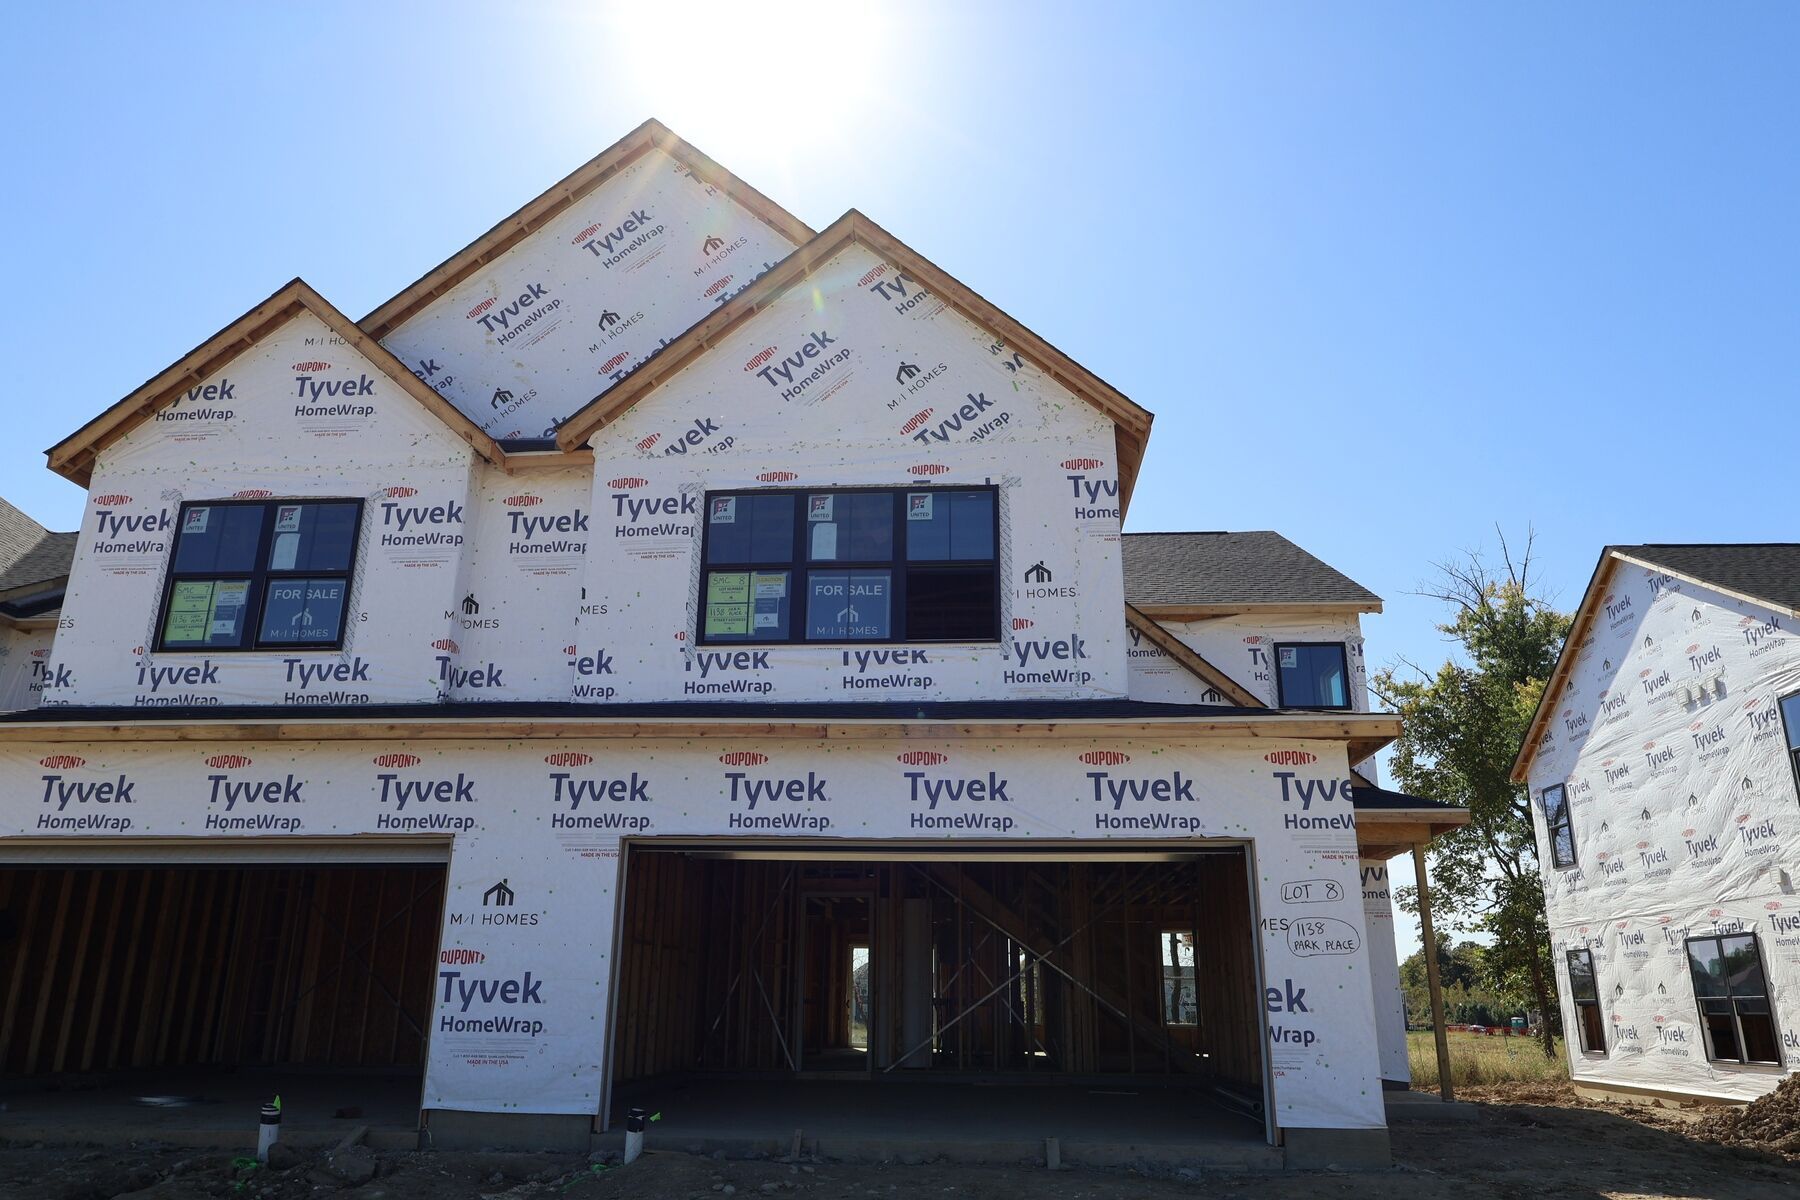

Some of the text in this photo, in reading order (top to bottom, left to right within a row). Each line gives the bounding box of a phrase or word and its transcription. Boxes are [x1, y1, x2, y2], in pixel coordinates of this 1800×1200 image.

[574, 223, 600, 244] DUPONT
[582, 207, 652, 258] Tyvek
[602, 223, 665, 269] HomeWrap
[711, 236, 748, 264] HOMES
[860, 263, 888, 286] DUPONT
[705, 275, 732, 297] DUPONT
[469, 297, 494, 318] DUPONT
[477, 282, 549, 332] Tyvek
[497, 298, 561, 346] HomeWrap
[608, 311, 645, 340] HOMES
[296, 361, 328, 373] DUPONT
[600, 352, 627, 374] DUPONT
[746, 346, 776, 372] DUPONT
[756, 329, 836, 388] Tyvek
[781, 347, 851, 402] HomeWrap
[907, 362, 949, 396] HOMES
[295, 374, 375, 403] Tyvek
[155, 408, 234, 421] HomeWrap
[294, 404, 374, 417] HomeWrap
[499, 389, 538, 419] HOMES
[903, 407, 932, 435] DUPONT
[913, 390, 994, 447] Tyvek
[911, 464, 945, 476] DUPONT
[1065, 458, 1099, 470] DUPONT
[611, 477, 644, 489] DUPONT
[760, 471, 794, 482] DUPONT
[1067, 475, 1118, 504] Tyv
[97, 495, 129, 506] DUPONT
[508, 496, 539, 507] DUPONT
[611, 493, 697, 522] Tyvek
[96, 508, 170, 539] Tyvek
[381, 500, 463, 531] Tyvek
[507, 509, 589, 539] Tyvek
[1075, 507, 1119, 520] Home
[93, 541, 164, 554] HomeWra
[381, 532, 464, 546] HomeWrap
[274, 589, 338, 600] FOR SALE
[815, 585, 882, 596] FOR SALE
[1026, 587, 1077, 599] HOMES
[580, 605, 608, 615] MES
[1606, 594, 1632, 620] Tyvek
[292, 629, 329, 637] HOMES
[839, 626, 878, 635] HOMES
[1742, 616, 1781, 646] Tyvek
[1688, 645, 1722, 673] Tyvek
[1749, 638, 1786, 659] HomeWrap
[283, 657, 370, 689] Tyvek
[435, 655, 503, 690] Tyvek
[842, 674, 933, 690] HomeWrap
[1642, 670, 1671, 695] Tyvek
[283, 690, 370, 704] HomeWrap
[684, 680, 773, 694] HomeWrap
[133, 694, 218, 705] HomeWrap
[1600, 692, 1627, 716] Tyvek
[1565, 711, 1588, 733] Tyvek
[1746, 707, 1778, 731] Tyve
[1692, 725, 1726, 752] Tyvek
[44, 755, 82, 769] DUPONT
[210, 755, 248, 769] DUPONT
[379, 754, 416, 768] DUPONT
[550, 752, 589, 767] DUPONT
[725, 752, 764, 766] DUPONT
[903, 752, 943, 766] DUPONT
[1085, 751, 1125, 765] DUPONT
[1270, 750, 1312, 765] DUPONT
[1645, 746, 1675, 769] Tyvek
[1604, 763, 1630, 785] Tyvek
[41, 774, 135, 811] Tyvek
[207, 774, 304, 811] Tyvek
[376, 773, 475, 811] Tyvek
[549, 772, 650, 810] Tyvek
[724, 771, 827, 810] Tyvek
[903, 771, 1009, 810] Tyvek
[1086, 771, 1195, 810] Tyvek
[1272, 771, 1353, 810] Tyve
[1567, 778, 1591, 798] Tyvek
[37, 814, 131, 832] HomeWrap
[205, 814, 302, 832] HomeWrap
[376, 813, 475, 832] HomeWrap
[551, 813, 650, 831] HomeWrap
[729, 813, 830, 832] HomeWrap
[910, 813, 1014, 832] HomeWrap
[1095, 813, 1201, 832] HomeWrap
[1284, 813, 1356, 830] HomeW
[1738, 820, 1776, 846] Tyvek
[1685, 834, 1718, 858] Tyvek
[1744, 843, 1780, 858] HomeWrap
[1599, 858, 1625, 878] Tyvek
[1640, 847, 1668, 869] Tyvek
[1283, 883, 1338, 900] LOT 8
[482, 913, 538, 925] HOMES
[1297, 922, 1325, 937] 1138
[1293, 939, 1355, 951] PARK PLACE
[1619, 930, 1646, 950] Tyvek
[440, 950, 480, 965] DUPONT
[439, 971, 542, 1012] Tyvek
[440, 1016, 543, 1037] HomeWrap
[1614, 1025, 1639, 1043] Tyvek
[1656, 1025, 1686, 1045] Tyvek
